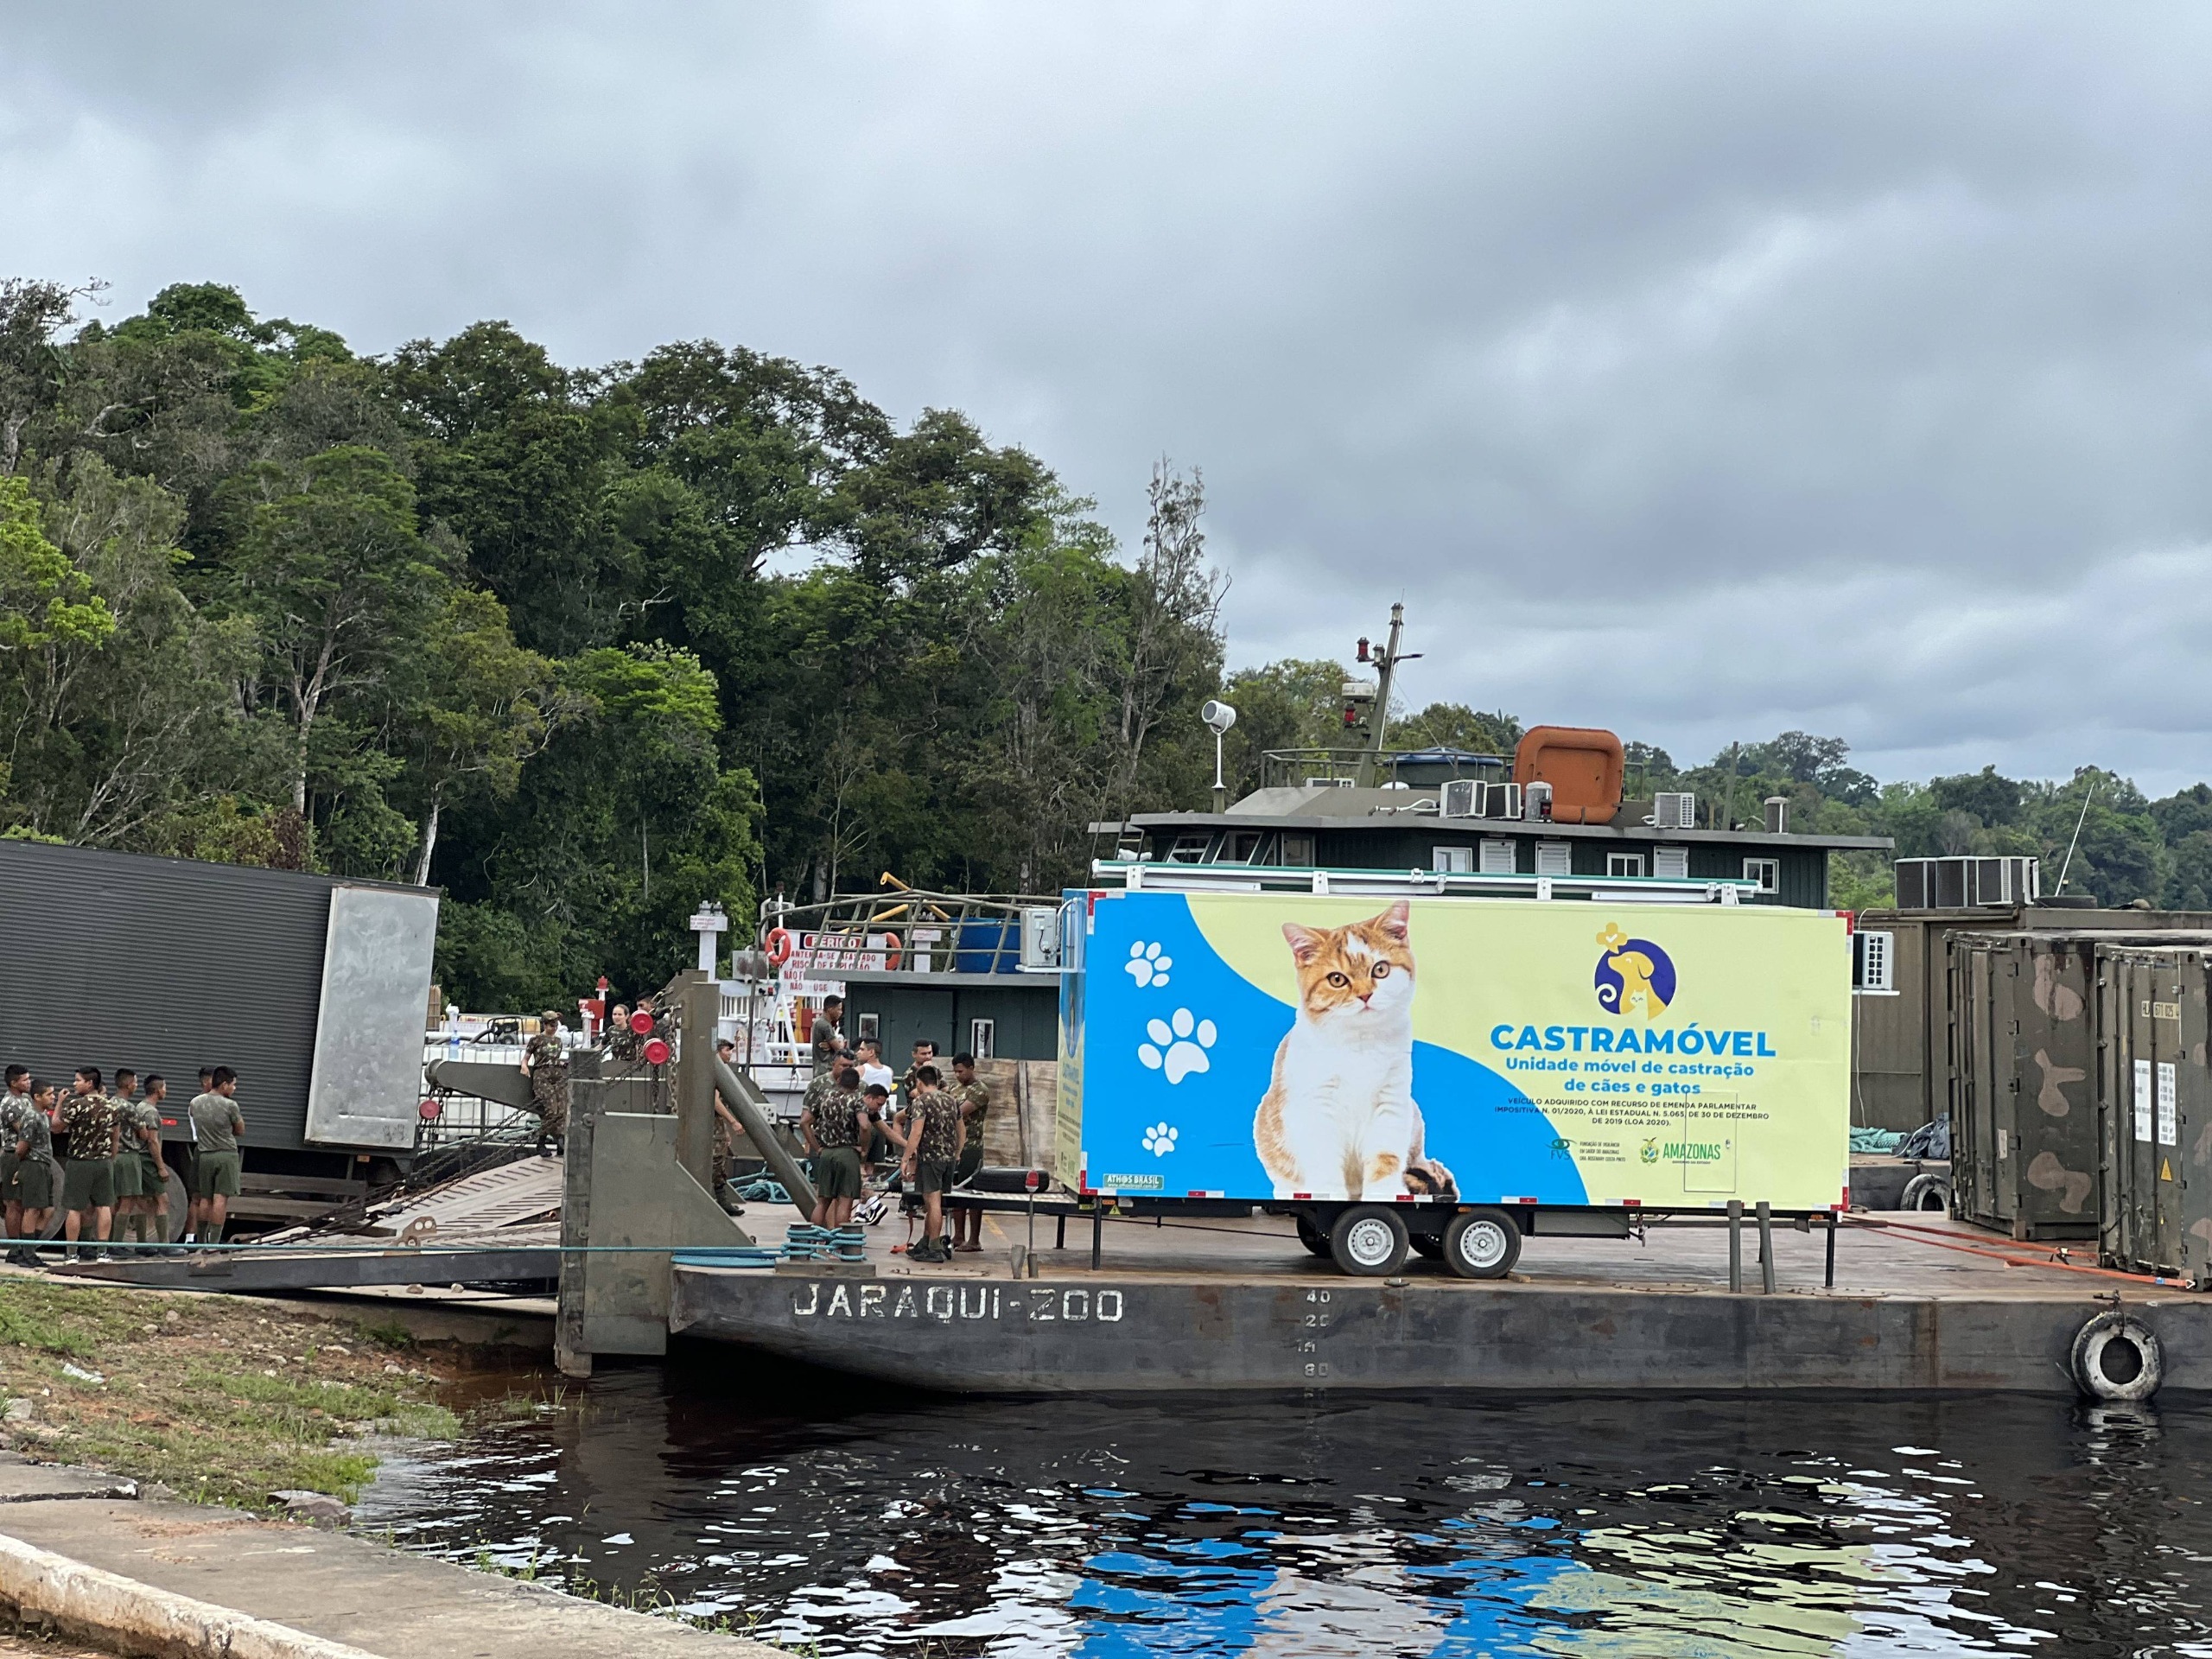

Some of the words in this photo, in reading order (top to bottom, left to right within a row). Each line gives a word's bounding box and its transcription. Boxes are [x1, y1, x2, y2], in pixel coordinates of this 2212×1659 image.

[790, 980, 803, 990] NÃO
[813, 983, 828, 992] USE
[1491, 1022, 1777, 1057] CASTRAMÓVEL
[1506, 1057, 1579, 1071] Unidade
[1584, 1059, 1636, 1073] móvel
[1641, 1061, 1663, 1074] de
[1668, 1063, 1754, 1079] castração
[1564, 1078, 1586, 1091] de
[1591, 1079, 1630, 1093] cães
[1636, 1083, 1646, 1093] e
[1651, 1082, 1701, 1096] gatos
[1508, 1096, 1542, 1105] VEÍCULO
[1551, 1149, 1571, 1160] FVS
[1662, 1142, 1721, 1160] AMAZONAS
[1134, 1175, 1160, 1185] BRASIL
[1306, 1289, 1331, 1303] 40
[1304, 1363, 1329, 1376] 80
